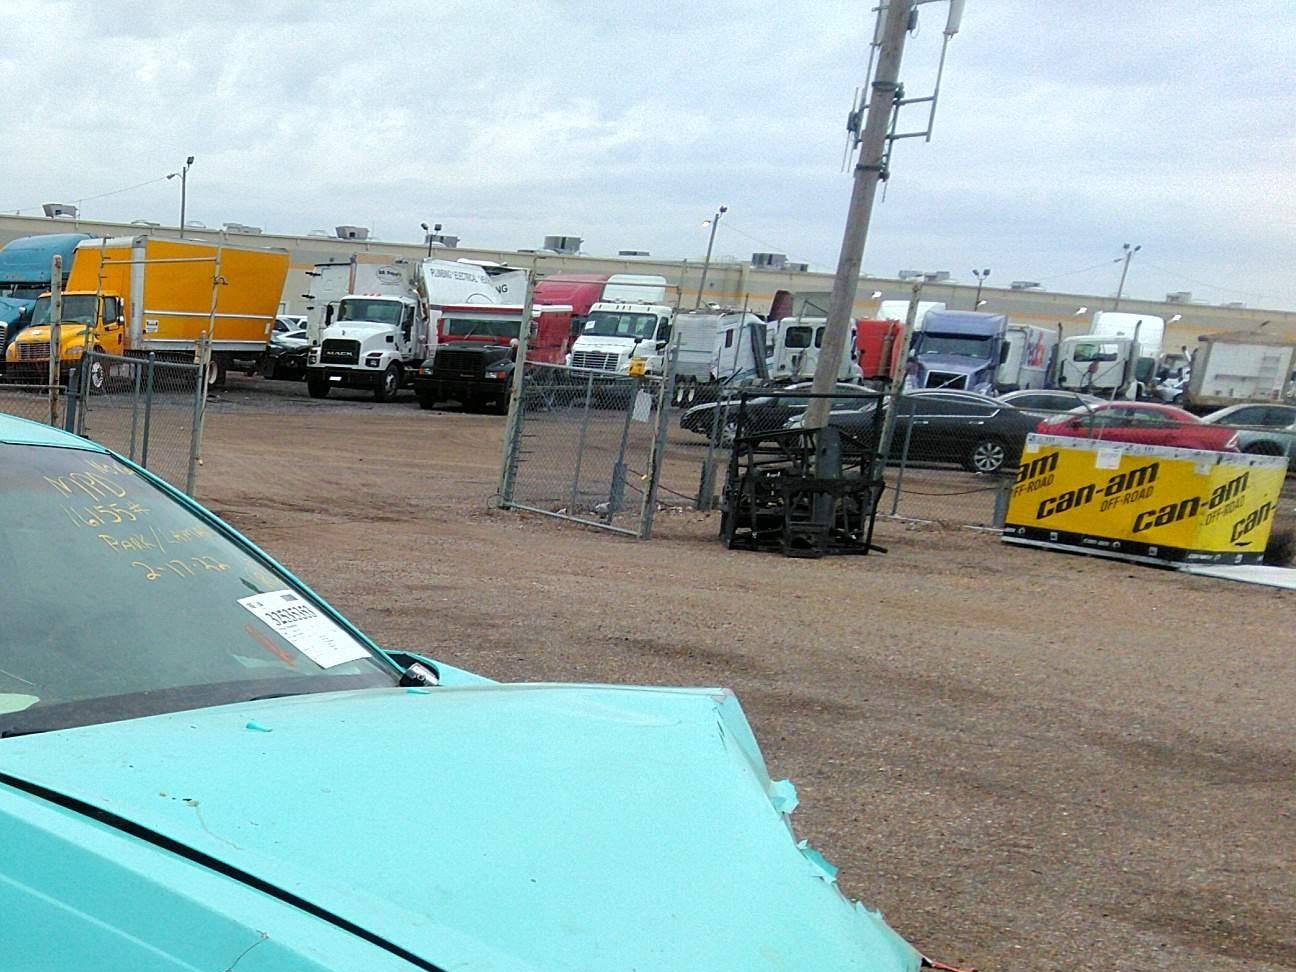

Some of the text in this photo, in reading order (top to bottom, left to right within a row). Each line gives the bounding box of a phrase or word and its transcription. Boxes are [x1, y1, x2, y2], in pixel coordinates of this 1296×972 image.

[1036, 462, 1160, 520] can-am
[1100, 486, 1154, 513] OFF-ROAD
[1132, 471, 1250, 534] can-am
